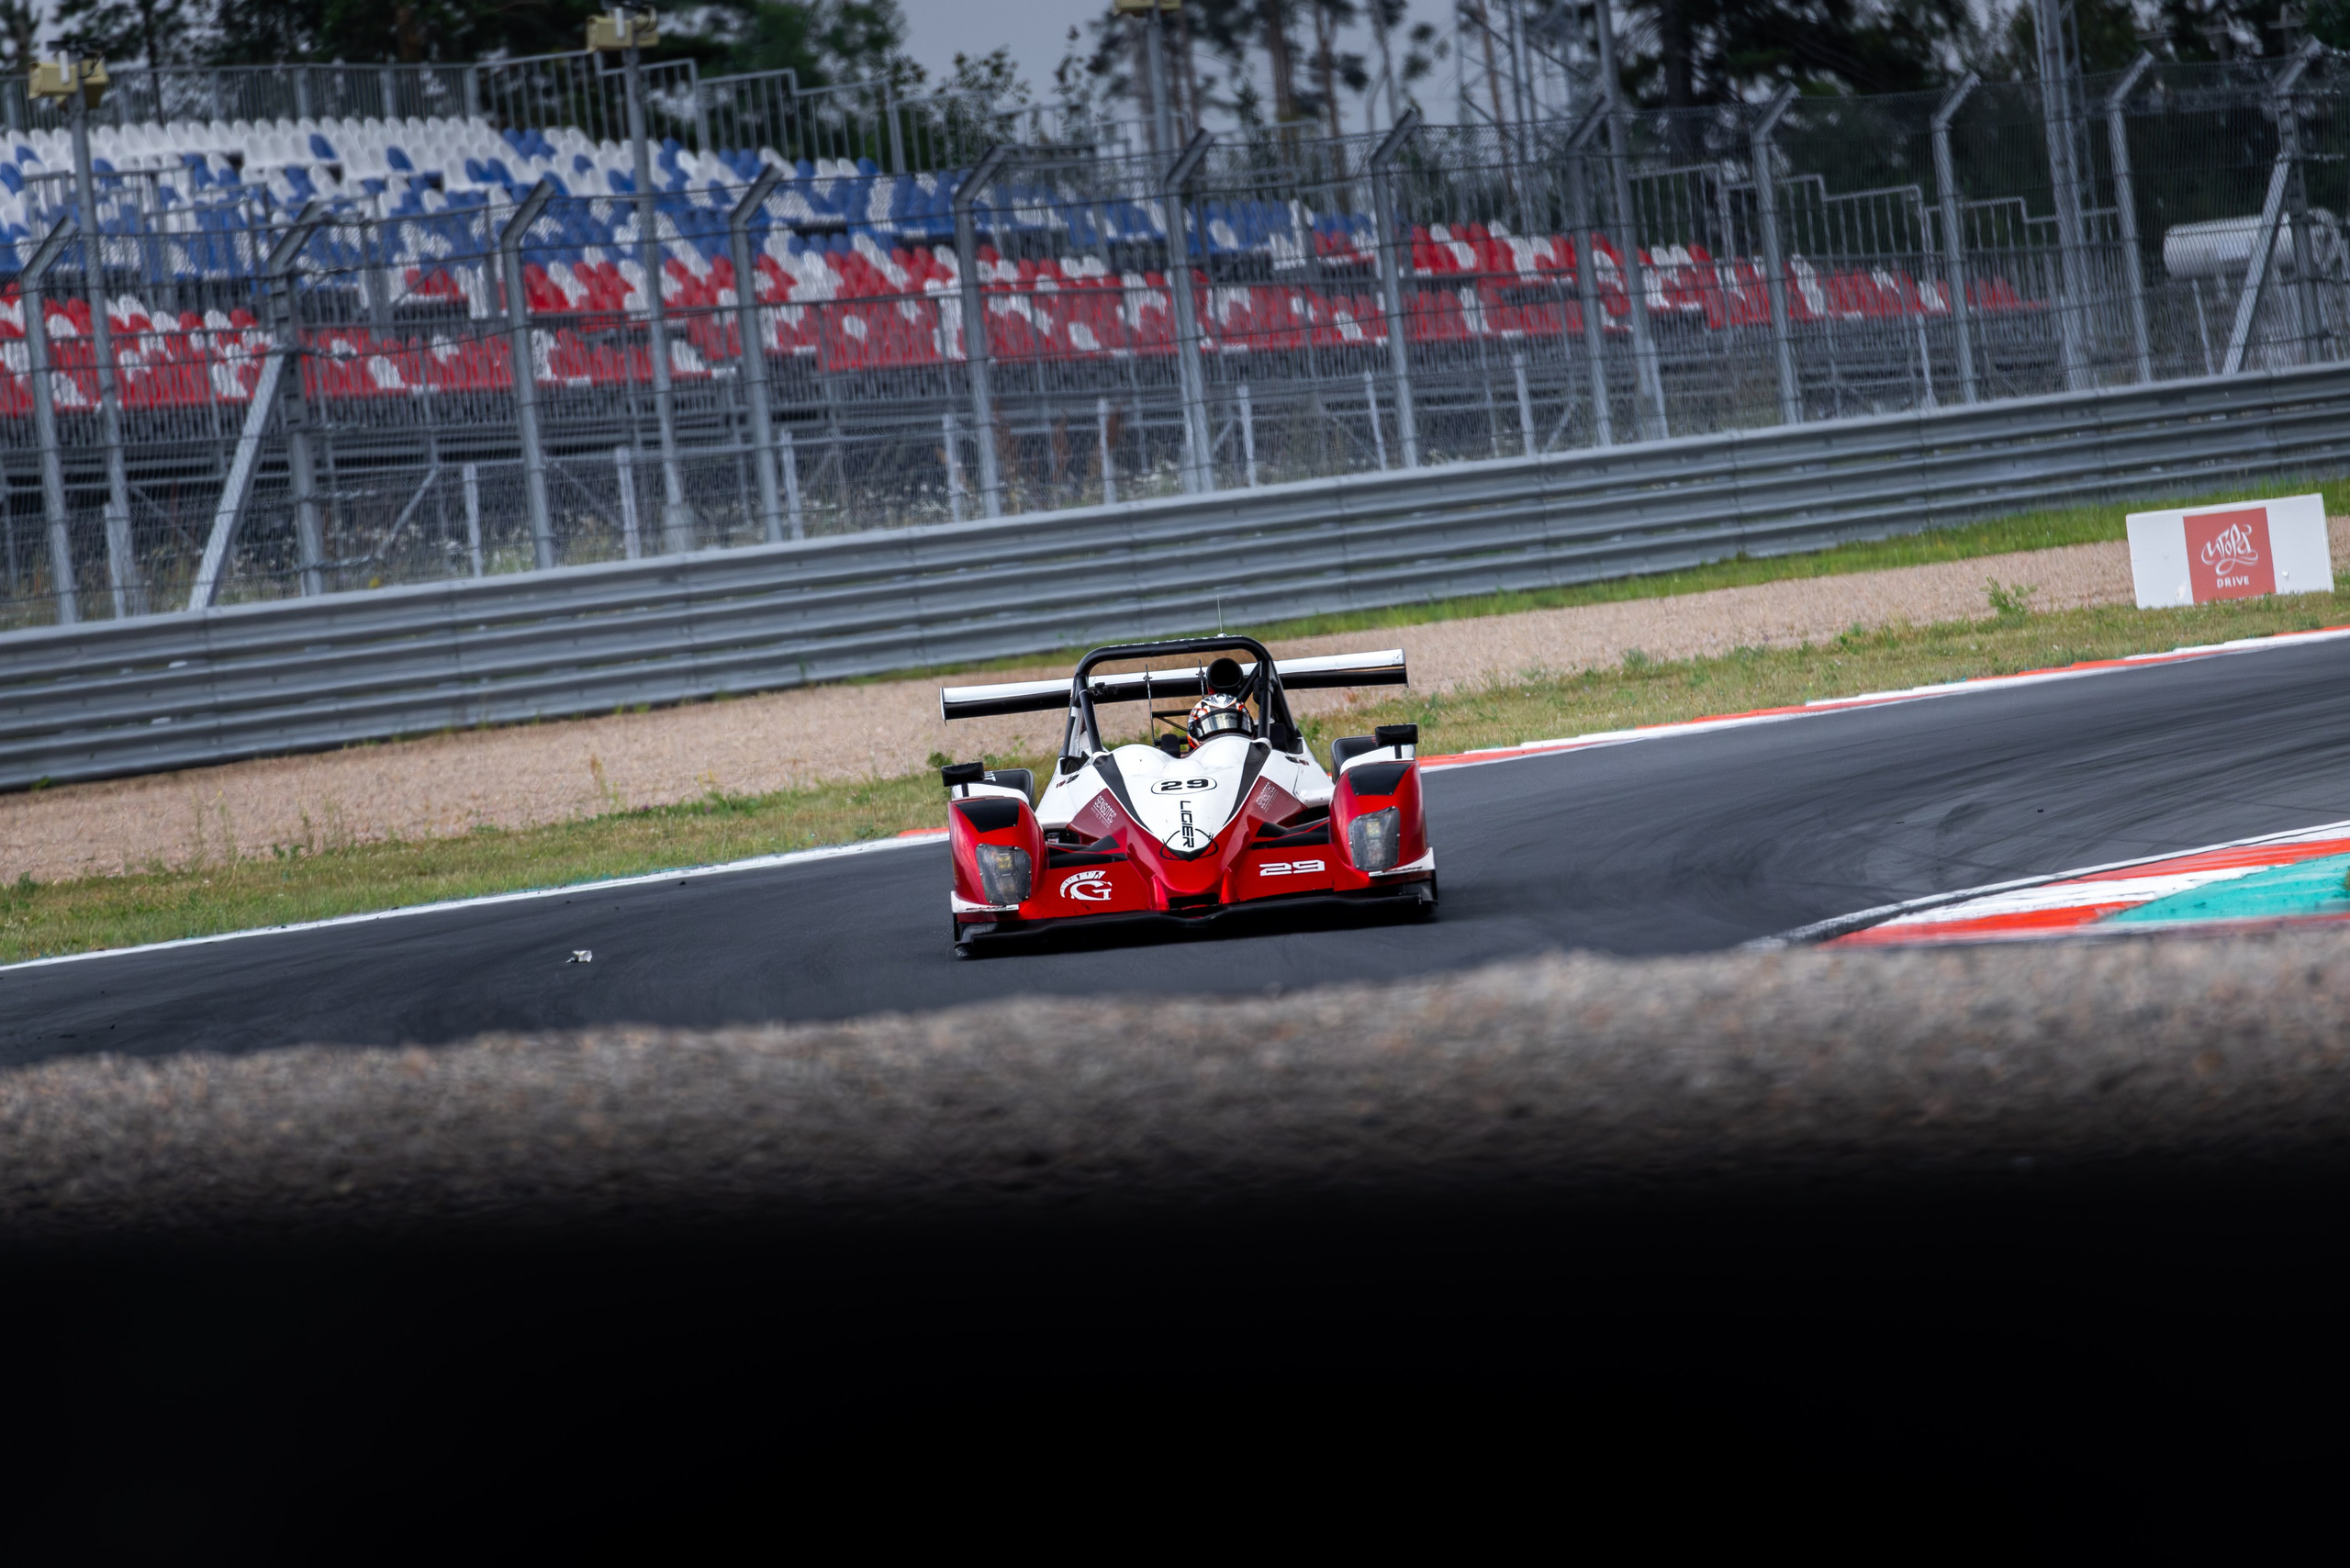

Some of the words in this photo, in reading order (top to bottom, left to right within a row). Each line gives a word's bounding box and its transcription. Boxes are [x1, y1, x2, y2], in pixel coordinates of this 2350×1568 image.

[2216, 576, 2250, 588] DRIVE
[1160, 778, 1209, 791] 29
[1093, 795, 1117, 823] SENSOTEC
[1180, 801, 1195, 847] LIGIER
[1259, 859, 1326, 877] 29
